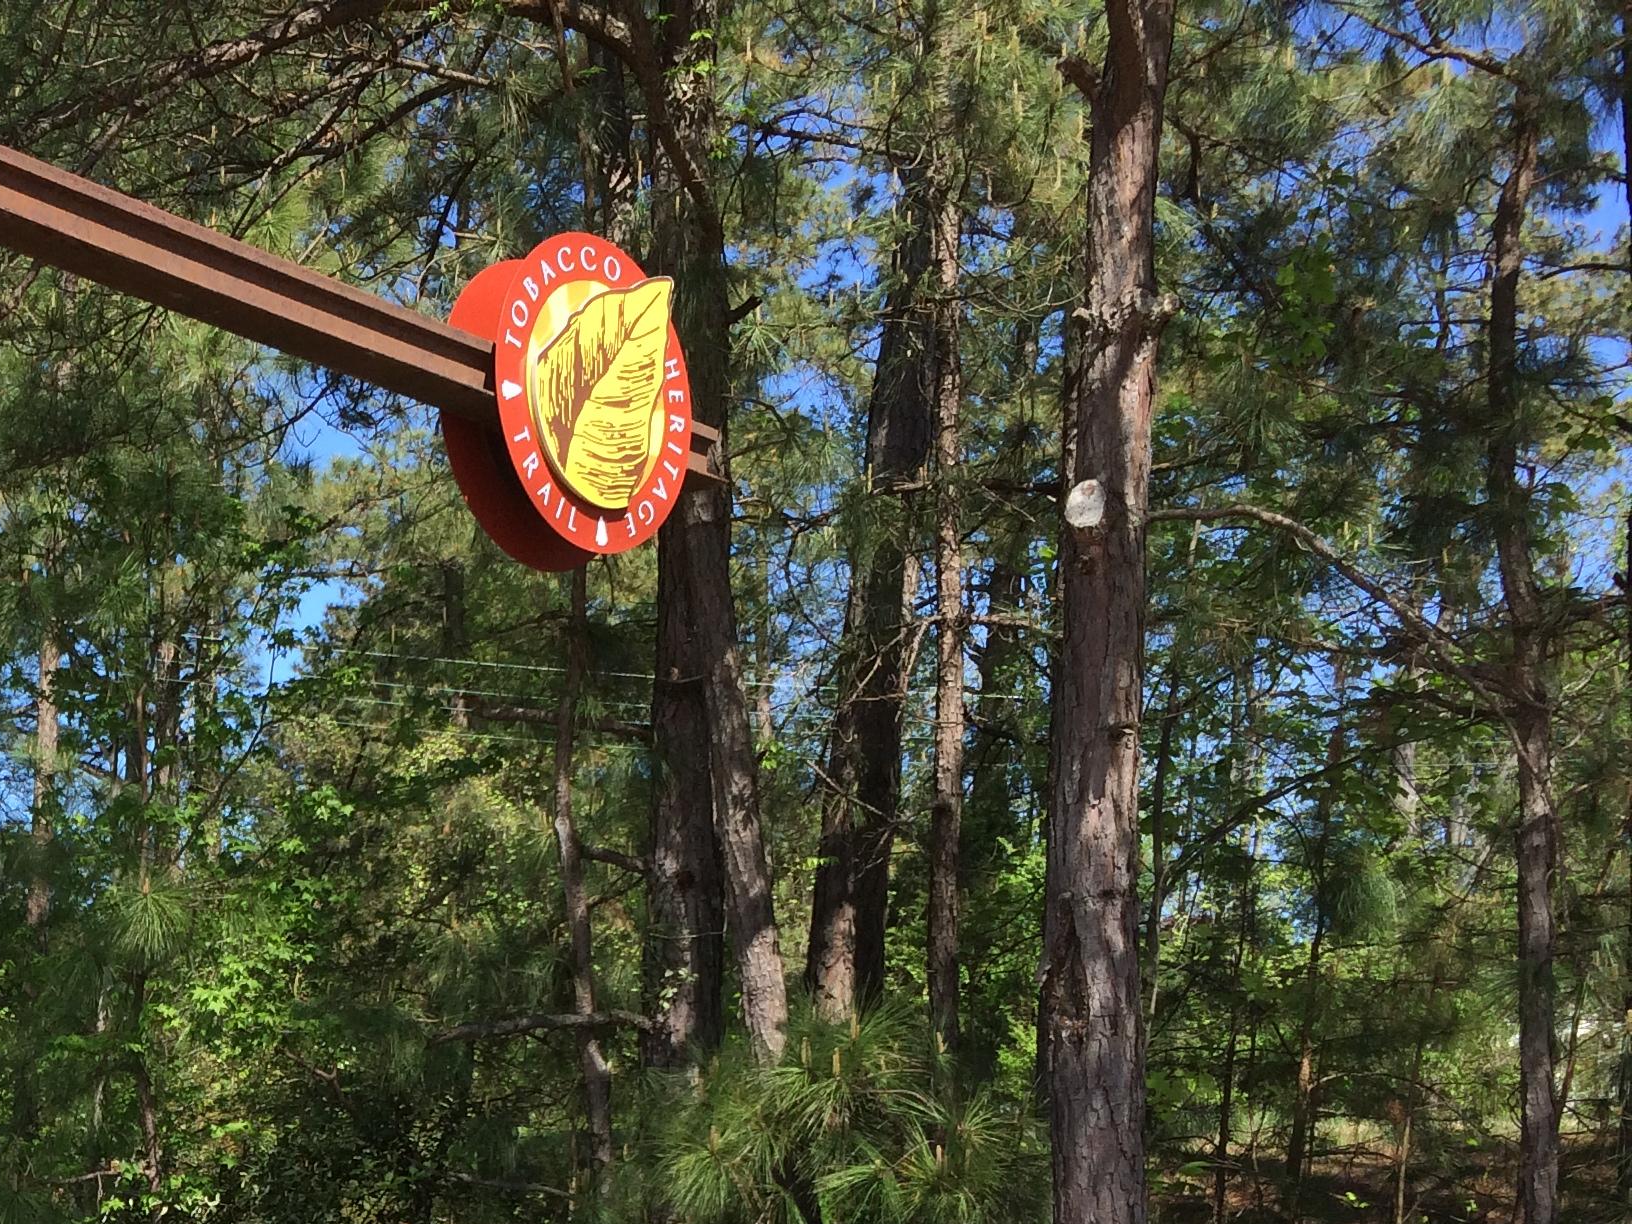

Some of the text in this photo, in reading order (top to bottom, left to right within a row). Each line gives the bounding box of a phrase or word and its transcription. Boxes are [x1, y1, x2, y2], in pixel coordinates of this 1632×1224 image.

[505, 246, 686, 538] TOBACCO HERITAGE TRAIL
